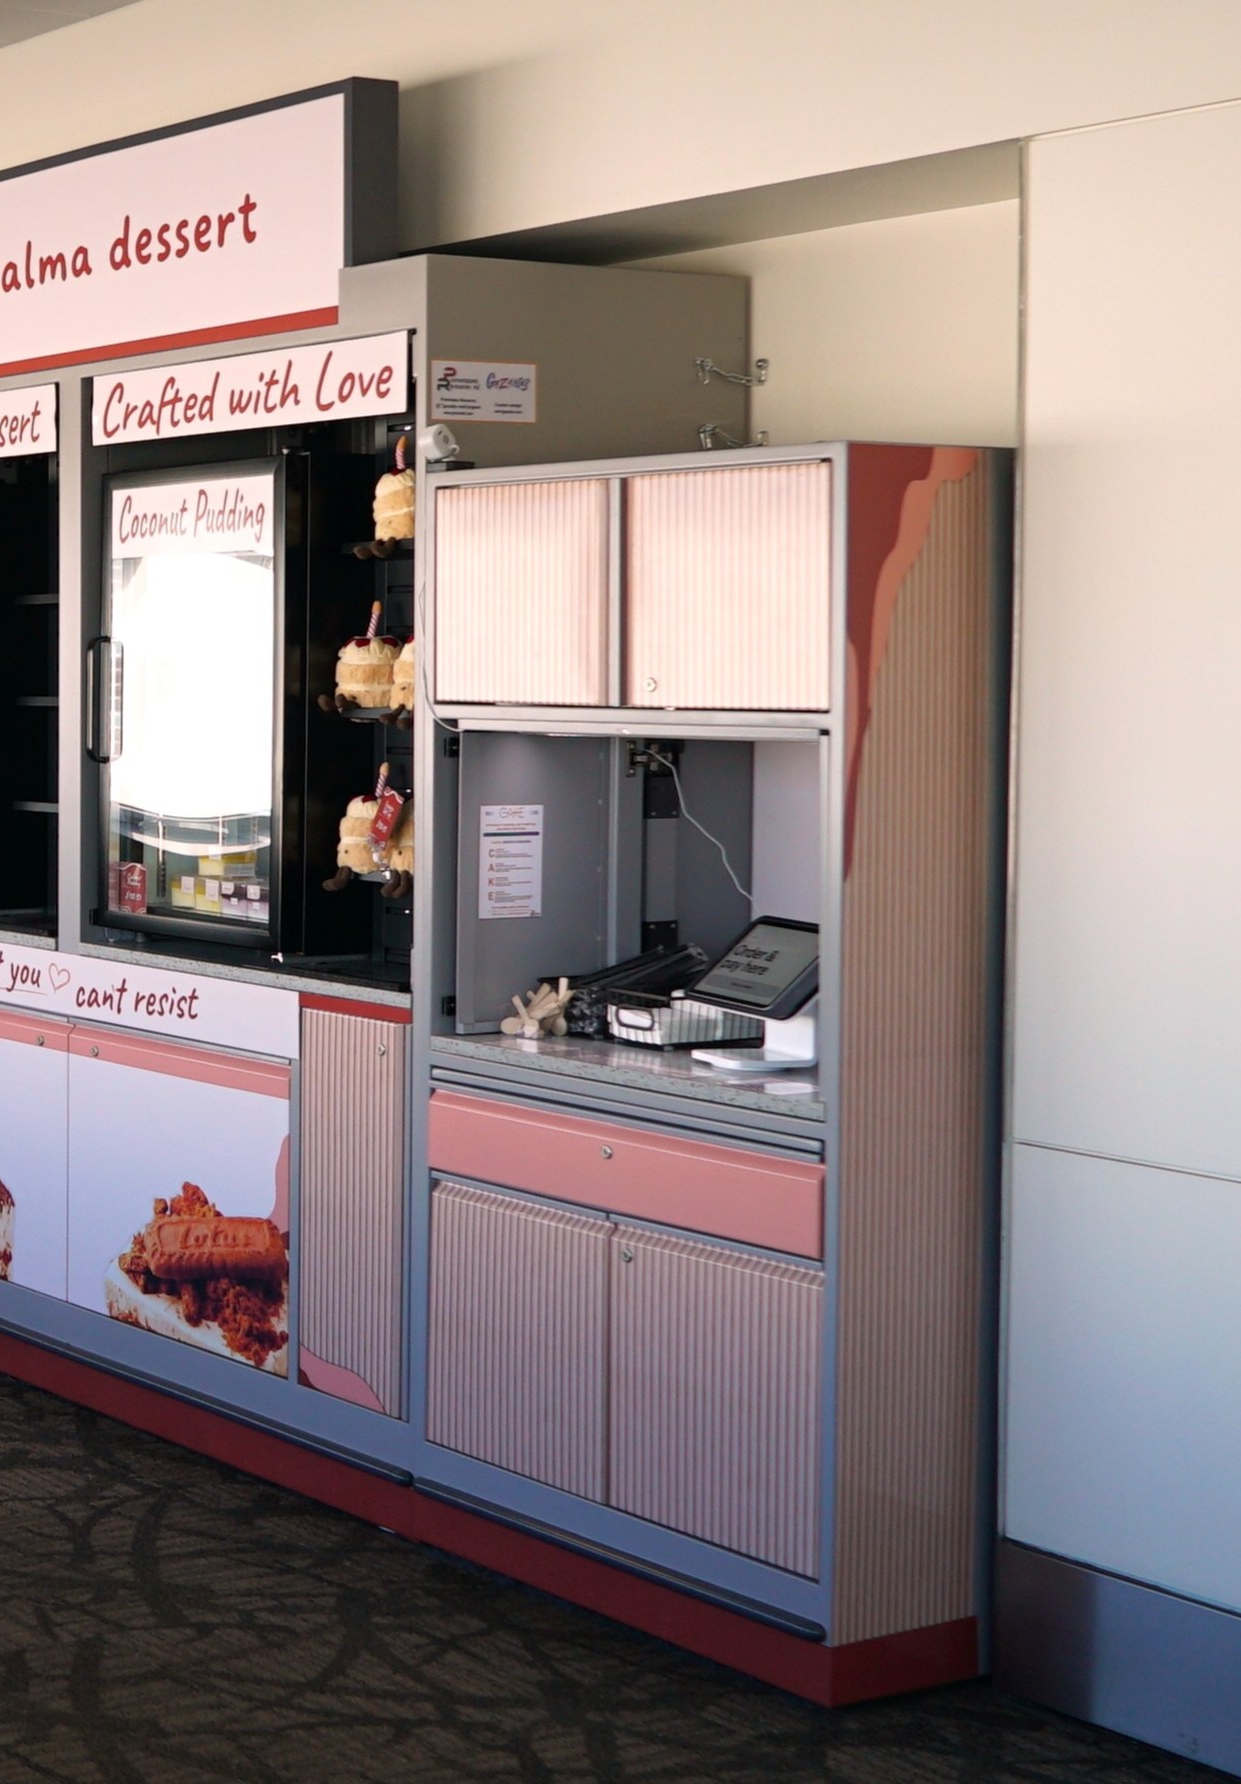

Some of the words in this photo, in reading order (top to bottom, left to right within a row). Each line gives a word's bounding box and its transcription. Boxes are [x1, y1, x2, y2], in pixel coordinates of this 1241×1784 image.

[1, 240, 92, 293] alma
[109, 193, 257, 271] dessert
[102, 371, 220, 438] Crafted
[228, 359, 301, 416] with
[315, 350, 394, 412] Love
[119, 495, 188, 544] Coconut
[193, 487, 266, 544] Pudding
[488, 849, 495, 858] C
[488, 863, 495, 872] A
[488, 878, 495, 886] K
[488, 891, 494, 901] E
[9, 963, 41, 993] you
[134, 987, 200, 1020] resist
